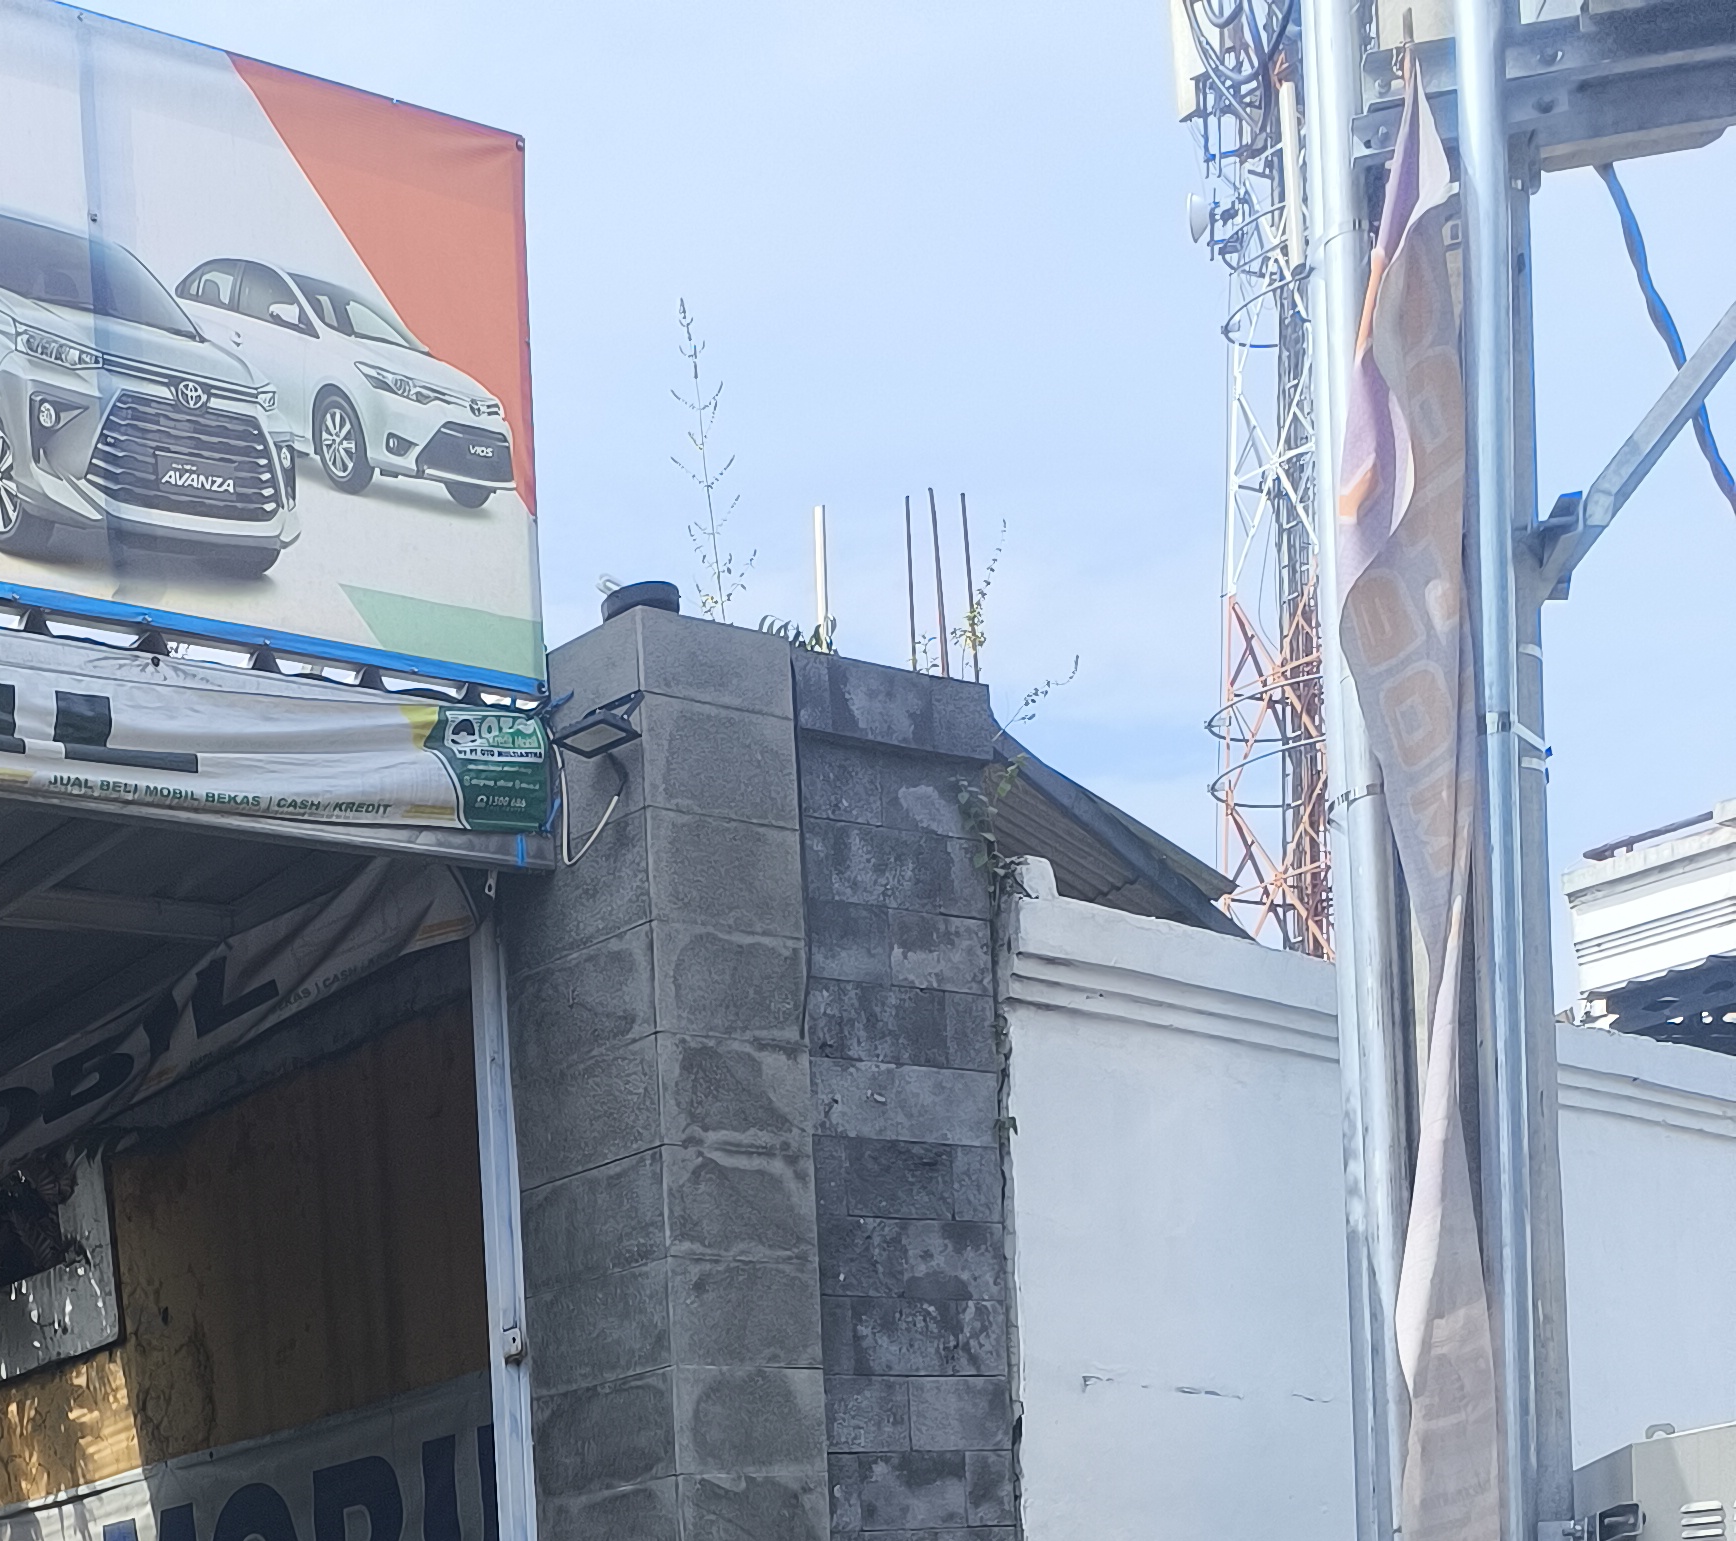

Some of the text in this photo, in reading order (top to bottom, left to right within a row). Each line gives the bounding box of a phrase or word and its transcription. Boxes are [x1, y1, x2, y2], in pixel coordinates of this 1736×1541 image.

[161, 470, 235, 494] AVANZA
[48, 773, 95, 791] JUAL
[99, 778, 138, 795] BELI
[144, 784, 200, 802] MOBIL
[204, 791, 262, 808] BEKAS
[276, 796, 321, 812] CASH
[332, 800, 393, 817] KREDIT
